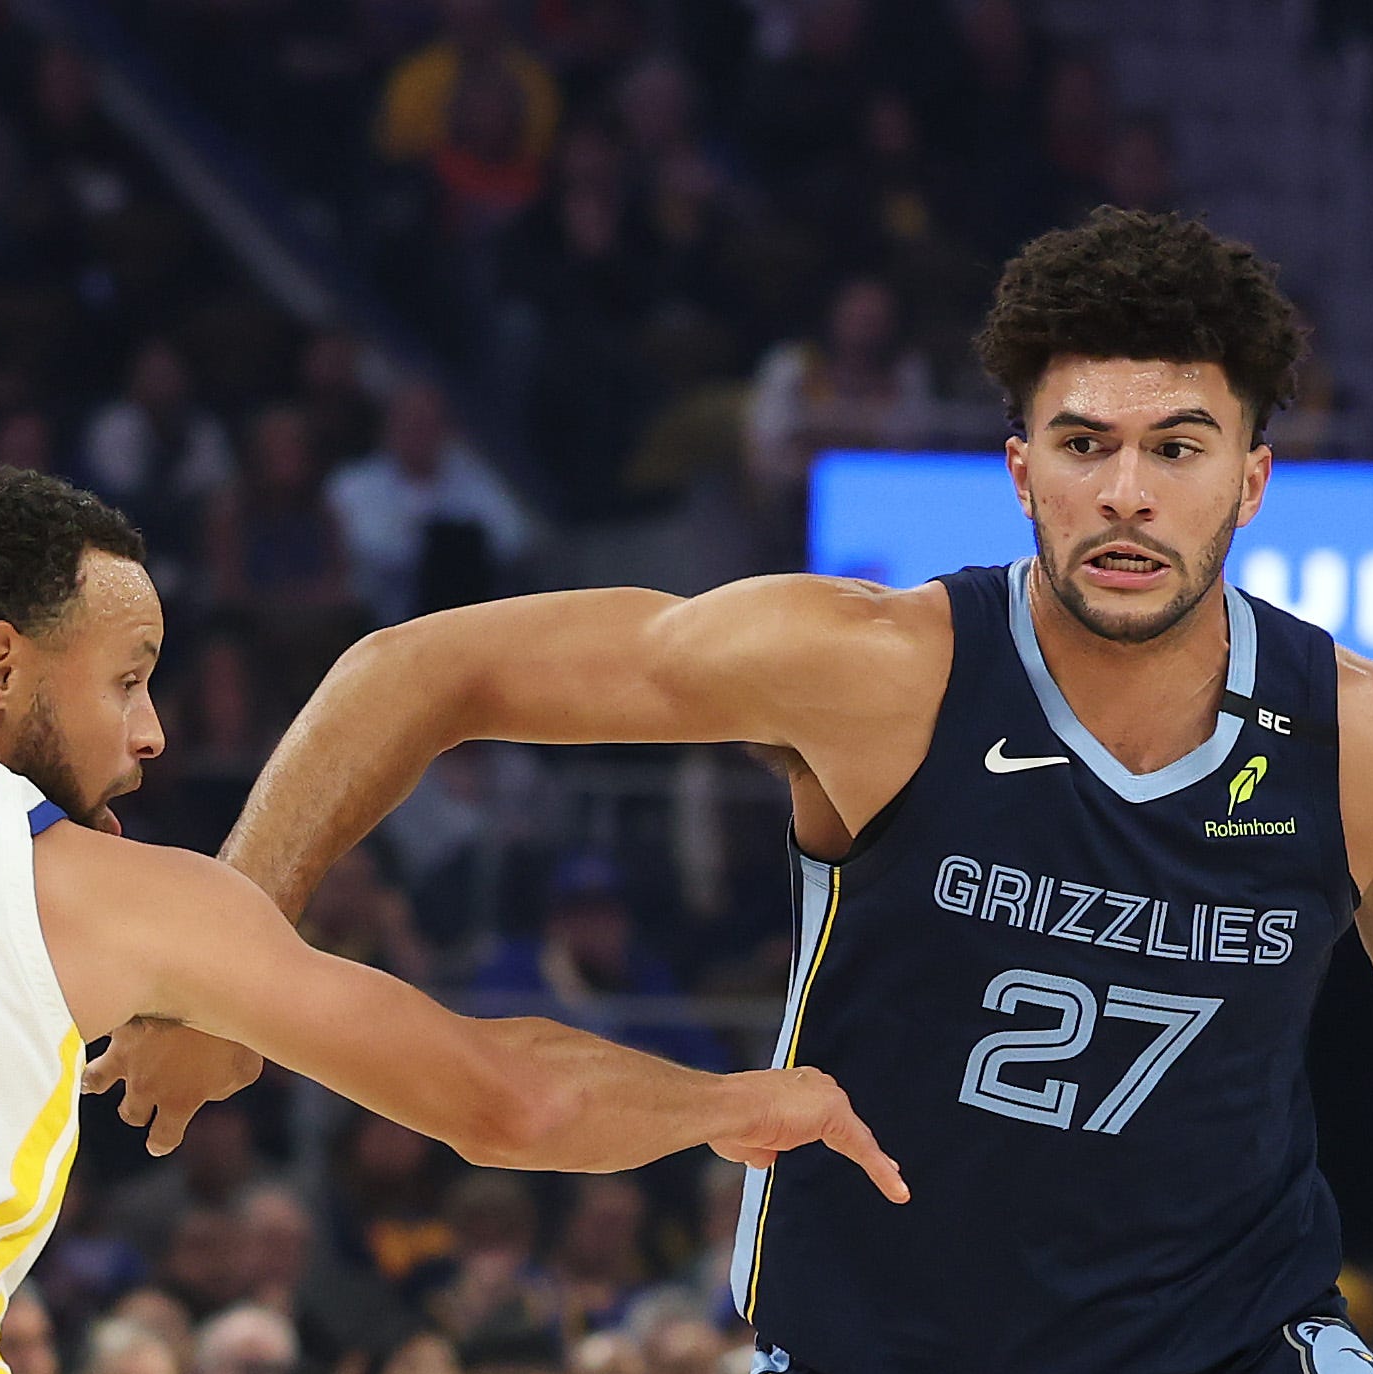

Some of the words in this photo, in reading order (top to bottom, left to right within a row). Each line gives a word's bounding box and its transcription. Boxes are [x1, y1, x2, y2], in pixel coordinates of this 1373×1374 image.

[1258, 707, 1291, 735] BC
[1204, 816, 1296, 838] Robinhood
[933, 855, 1298, 965] GRIZZLIES
[958, 968, 1225, 1135] 27
